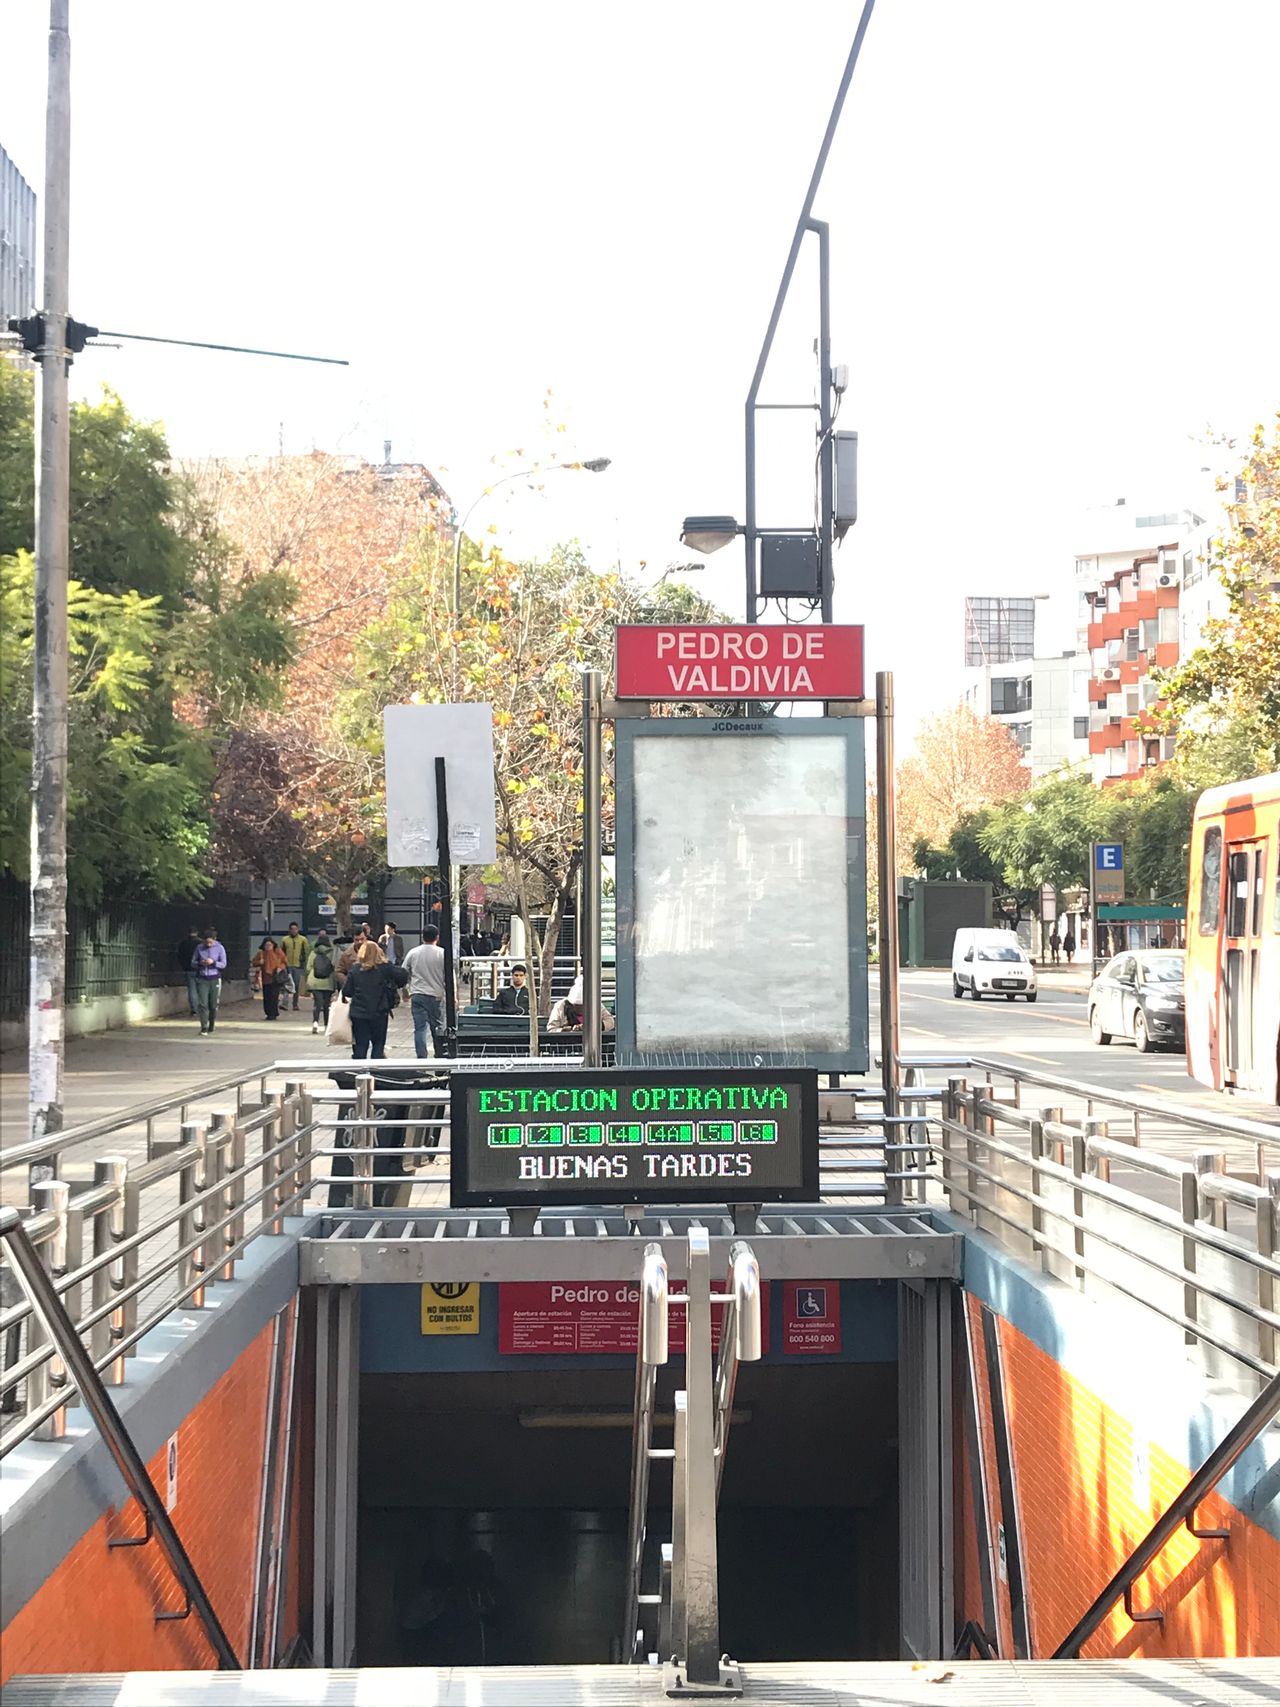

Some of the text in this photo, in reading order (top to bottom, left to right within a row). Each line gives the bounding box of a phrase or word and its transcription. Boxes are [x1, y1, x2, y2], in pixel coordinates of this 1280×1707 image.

[656, 632, 825, 660] PEDRO DE
[667, 665, 815, 692] VALDIVIA
[711, 722, 763, 732] JCDecaux
[1103, 848, 1115, 867] E
[479, 1087, 788, 1113] ESTACION OPERATIVA
[491, 1124, 761, 1144] L1 L2 L3 L4 L4A L5 L6
[518, 1153, 752, 1180] BUENAS TARDES
[551, 1286, 639, 1303] Pedro de
